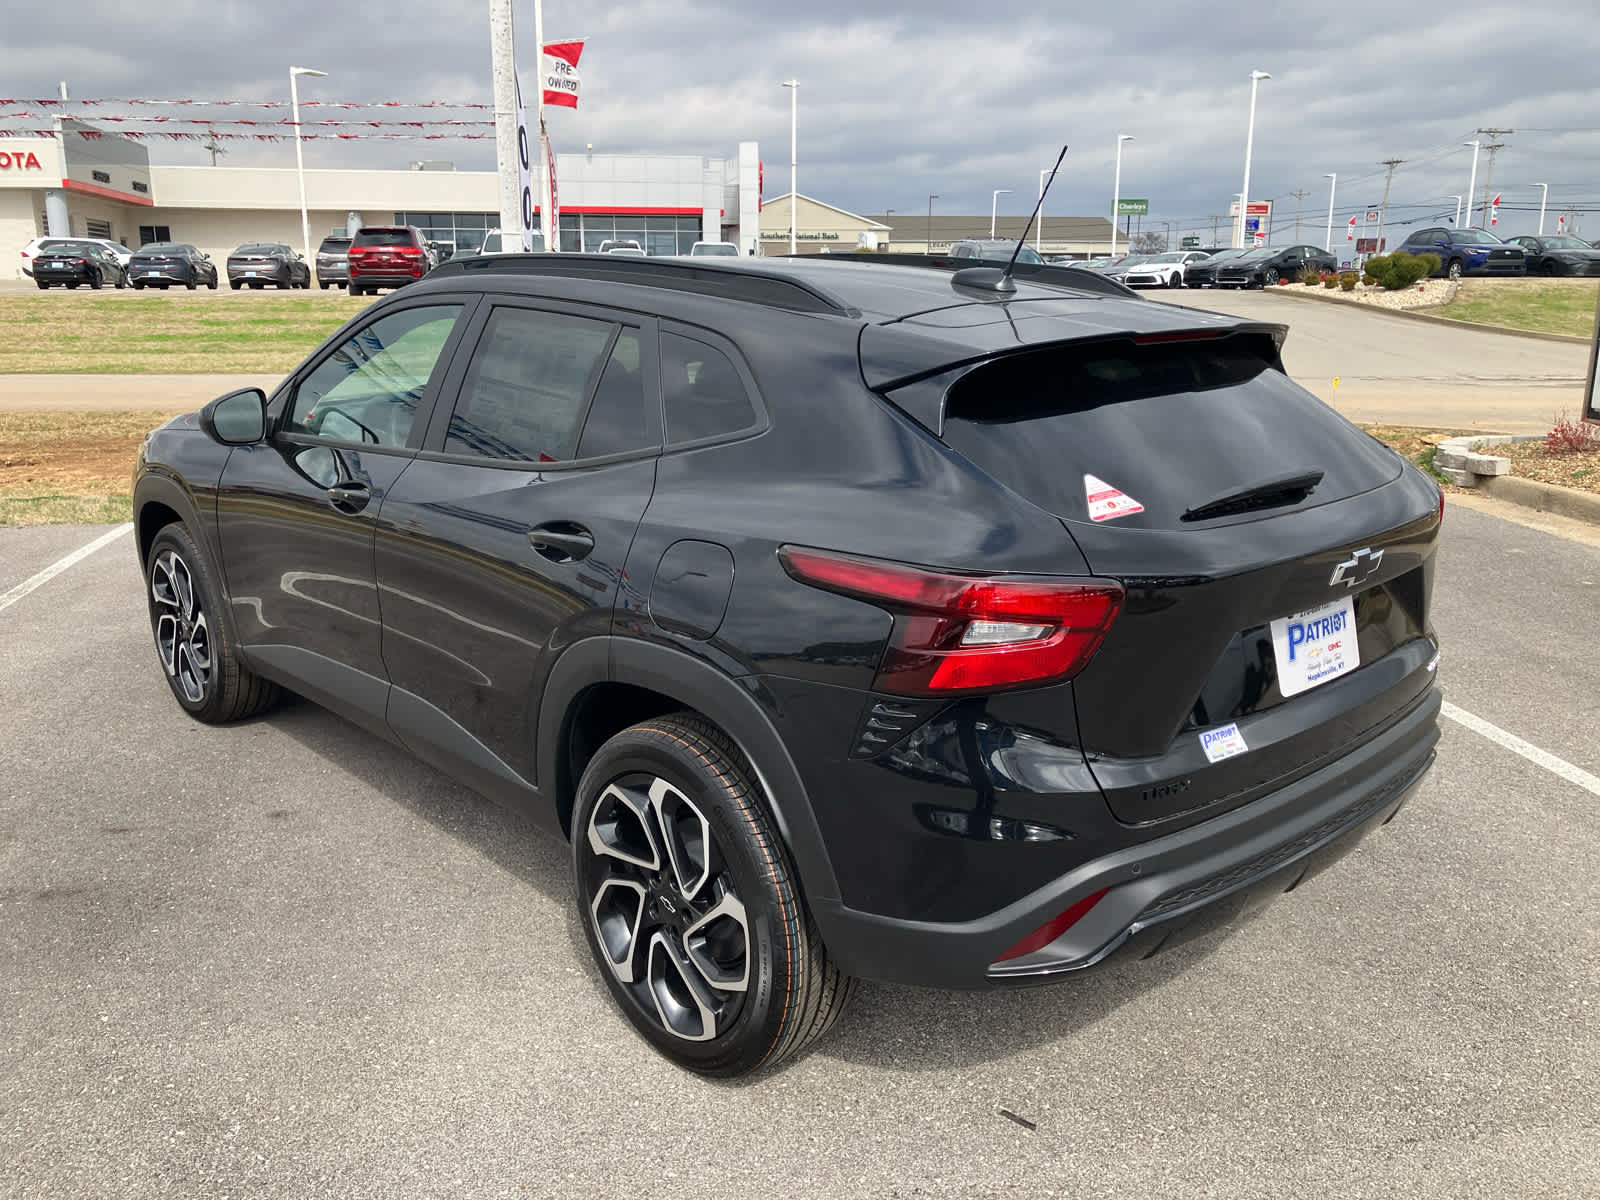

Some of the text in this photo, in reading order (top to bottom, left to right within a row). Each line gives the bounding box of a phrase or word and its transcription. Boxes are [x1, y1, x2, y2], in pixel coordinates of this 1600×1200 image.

[555, 62, 572, 75] PRE
[547, 76, 577, 91] OWNED
[0, 152, 41, 168] OTA
[1287, 609, 1347, 661] PATRIOT
[1327, 640, 1342, 651] GMC
[1203, 726, 1236, 749] PATRIOT
